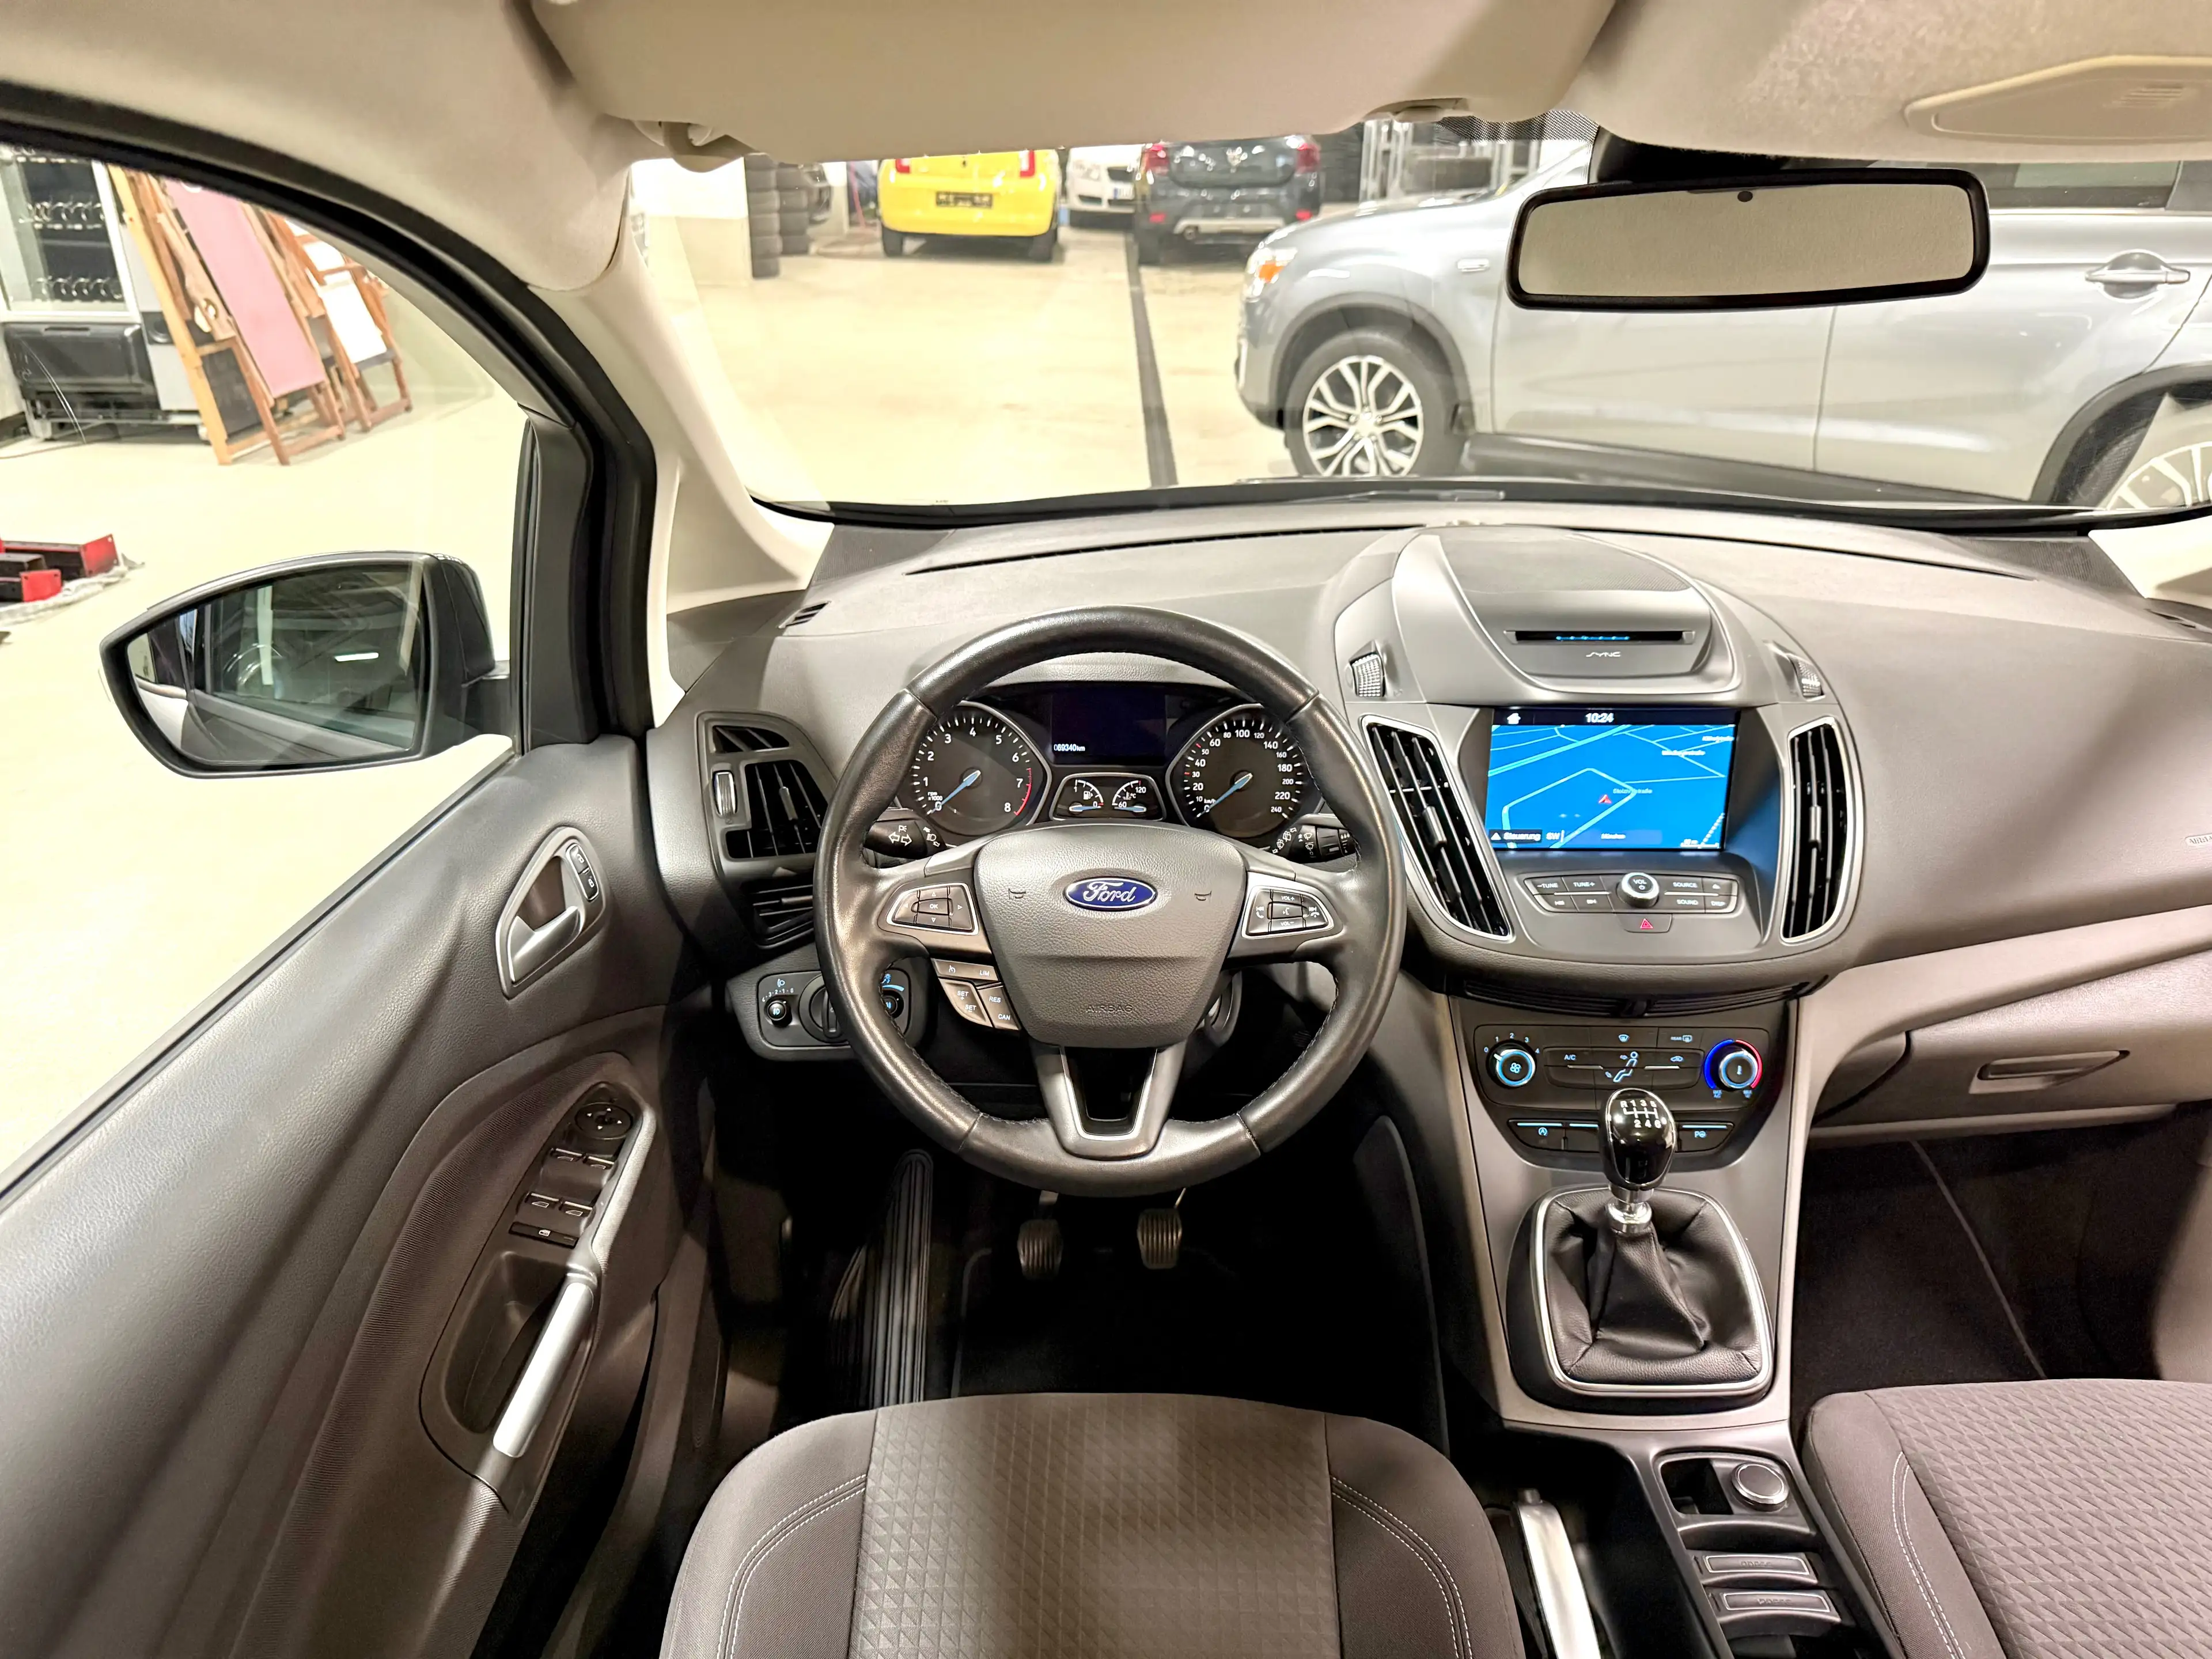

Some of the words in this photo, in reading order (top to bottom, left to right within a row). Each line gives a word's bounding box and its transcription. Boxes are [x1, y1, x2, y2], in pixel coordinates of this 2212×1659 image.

[1585, 713, 1614, 723] 10:24
[969, 728, 976, 737] 4
[1235, 729, 1250, 737] 100
[945, 734, 951, 744] 3
[996, 735, 1002, 744] 5
[1210, 738, 1221, 747] 60
[1263, 741, 1278, 749] 140
[928, 752, 934, 761] 2
[1012, 753, 1019, 762] 6
[1195, 759, 1206, 767] 40
[1277, 764, 1293, 772] 180
[923, 778, 928, 786] 1
[1017, 779, 1023, 788] 7
[1193, 783, 1204, 791] 20
[1004, 802, 1011, 812] 8
[1083, 881, 1137, 902] Ford
[1634, 1119, 1641, 1128] 2
[1645, 1120, 1652, 1128] 4
[1654, 1119, 1661, 1128] 6
